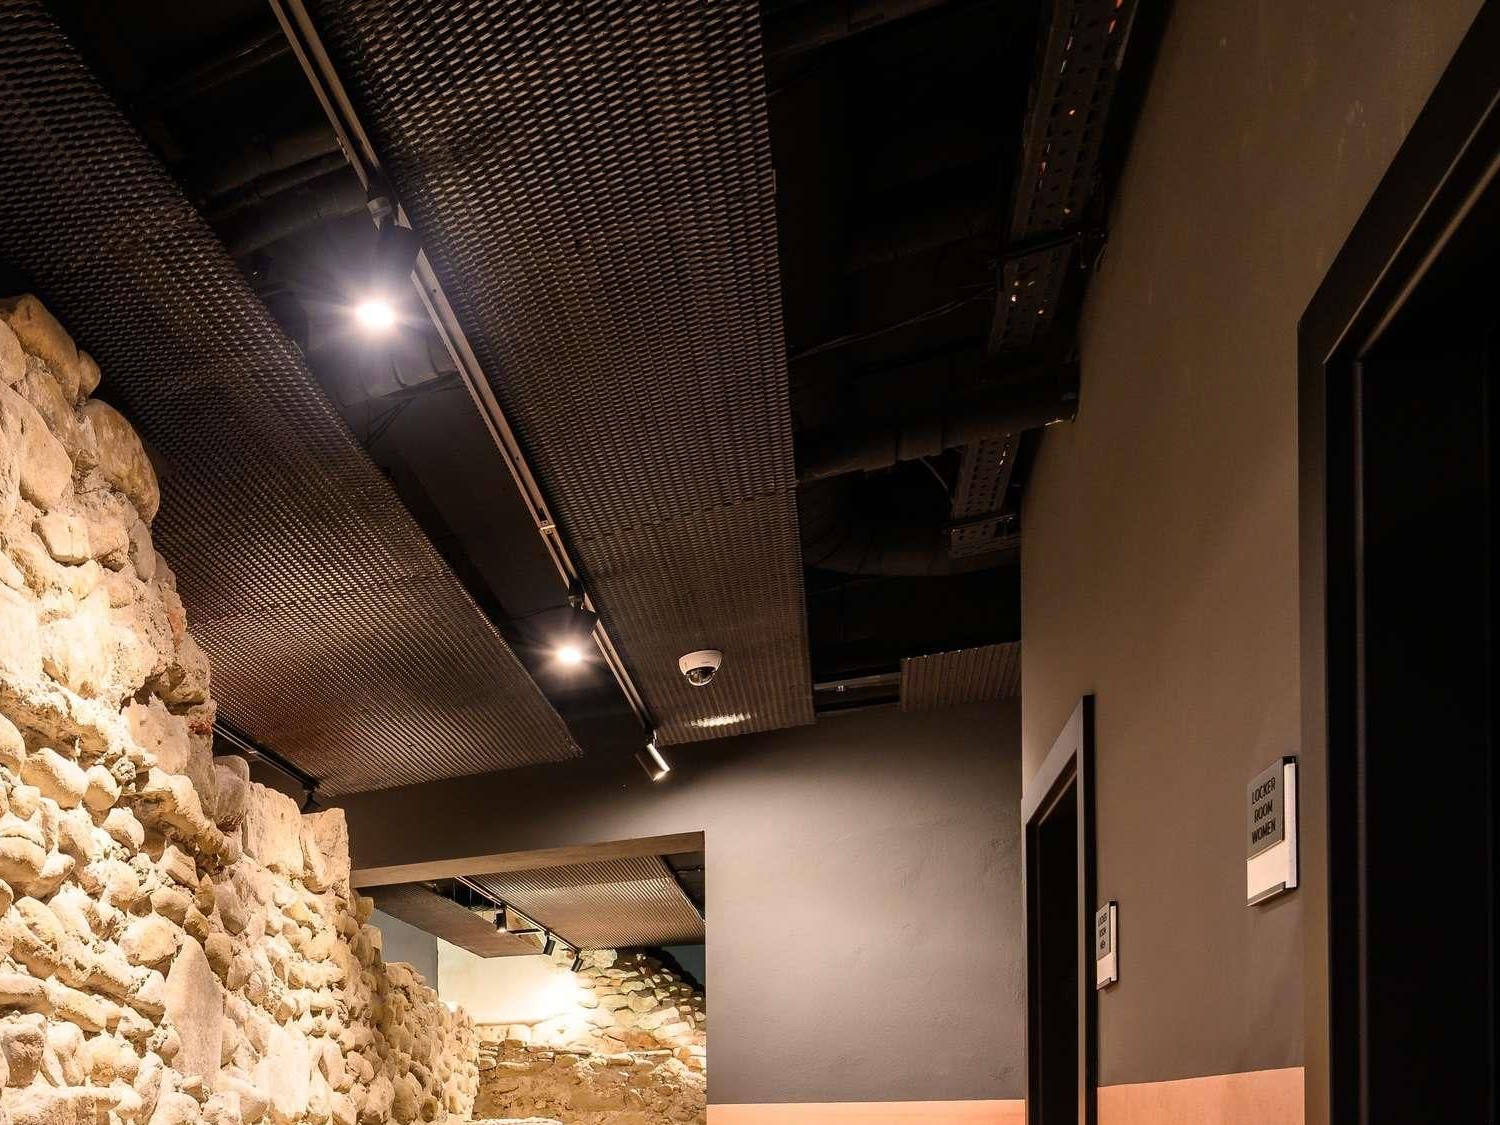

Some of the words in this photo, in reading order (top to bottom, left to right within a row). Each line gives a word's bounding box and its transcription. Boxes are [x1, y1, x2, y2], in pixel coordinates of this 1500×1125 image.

[1251, 776, 1276, 804] LOCKER
[1254, 800, 1273, 823] ROOM
[1251, 819, 1276, 845] WOMEN
